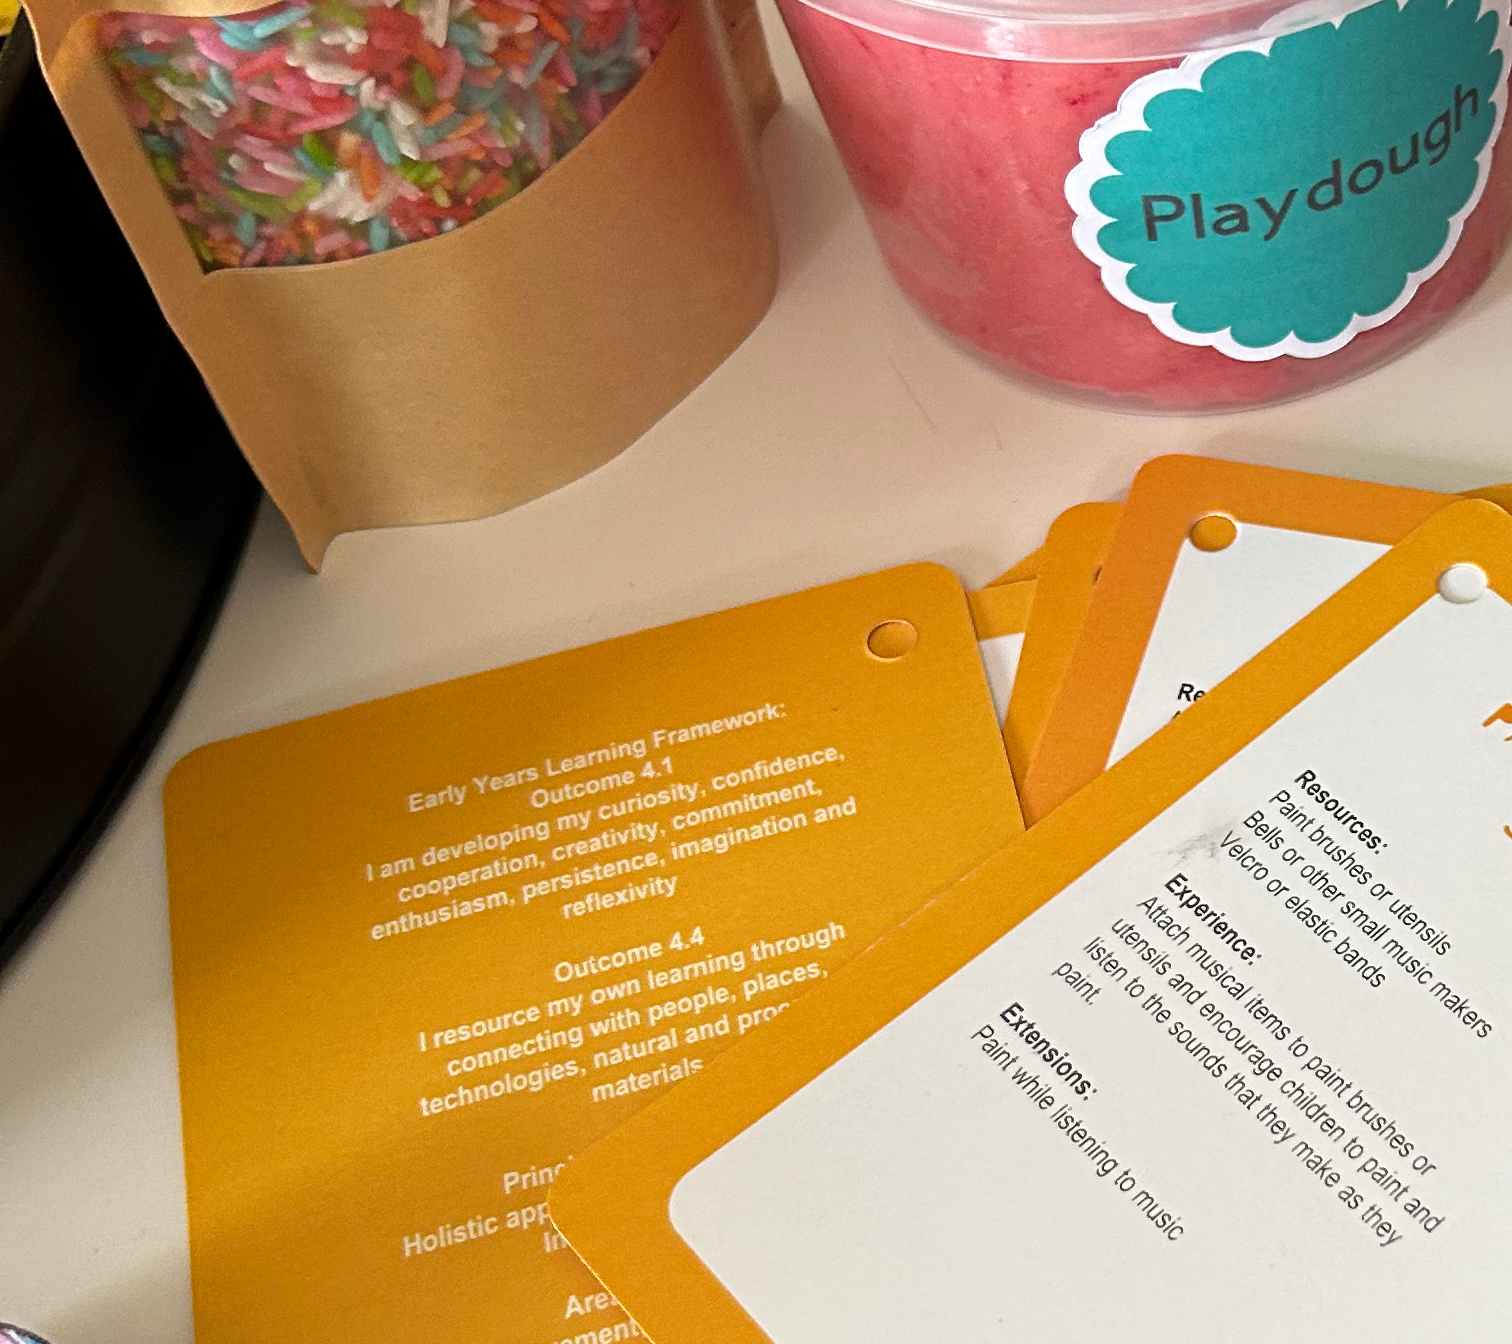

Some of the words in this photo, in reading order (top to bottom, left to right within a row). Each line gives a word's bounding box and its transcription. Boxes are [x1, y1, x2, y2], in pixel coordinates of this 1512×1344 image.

[1141, 83, 1480, 242] Playdough
[365, 863, 373, 881] I
[379, 856, 415, 878] am
[420, 820, 550, 866] developing
[555, 809, 591, 831] my
[597, 782, 706, 820] curiosity,
[710, 746, 845, 790] confidence,
[407, 784, 466, 812] Early
[472, 767, 539, 793] Years
[544, 738, 646, 776] Learning
[650, 702, 786, 748] Framework:
[529, 770, 635, 808] Outcome
[639, 755, 672, 778] 4.1
[1293, 769, 1387, 854] Resources:
[369, 890, 515, 940] enthusiasm,
[521, 851, 665, 903] persistence,
[670, 812, 808, 860] imagination
[813, 795, 856, 823] and
[396, 852, 545, 902] cooperation,
[551, 821, 665, 861] creativity,
[671, 777, 822, 830] commitment,
[559, 875, 677, 919] reflexivity
[1268, 789, 1315, 832] Paint
[1307, 824, 1372, 884] brushes
[1369, 883, 1393, 901] or
[1388, 898, 1451, 955] utensils
[553, 941, 662, 982] Outcome
[667, 925, 704, 950] 4.4
[1164, 872, 1261, 965] Experience:
[1219, 829, 1268, 880] Velcro
[1266, 878, 1290, 896] or
[1284, 895, 1337, 943] elastic
[1332, 936, 1385, 987] bands
[1242, 809, 1284, 850] Bells
[1281, 848, 1305, 866] or
[1299, 864, 1345, 902] other
[1339, 900, 1390, 942] small
[1381, 938, 1433, 984] music
[1428, 981, 1492, 1038] makers
[417, 1031, 427, 1052] I
[432, 1005, 540, 1048] resource
[545, 993, 583, 1016] my
[589, 978, 640, 1004] own
[646, 950, 745, 989] learning
[750, 921, 846, 961] through
[445, 1025, 583, 1076] connecting
[587, 1007, 640, 1037] with
[647, 985, 736, 1026] people,
[741, 962, 828, 1001] places,
[1051, 961, 1101, 1005] paint.
[1136, 896, 1190, 946] Attach
[1185, 942, 1253, 1000] musical
[1243, 993, 1290, 1040] items
[1287, 1035, 1308, 1057] to
[1300, 1055, 1352, 1098] paint
[1345, 1089, 1414, 1157] brushes
[1411, 1155, 1436, 1175] or
[418, 1059, 587, 1116] technologies,
[593, 1027, 678, 1068] natural
[683, 1013, 730, 1044] and
[999, 1001, 1097, 1101] Extensions:
[1082, 936, 1127, 982] listen
[1124, 976, 1145, 997] to
[1141, 992, 1171, 1023] the
[1167, 1021, 1227, 1078] sounds
[1223, 1072, 1262, 1110] that
[1255, 1102, 1295, 1144] they
[1291, 1140, 1340, 1187] make
[1337, 1185, 1363, 1209] as
[1361, 1203, 1402, 1247] they
[1111, 918, 1171, 975] utensils
[1167, 973, 1207, 1005] and
[1199, 1002, 1282, 1081] encourage
[1279, 1079, 1345, 1142] children
[1342, 1136, 1363, 1159] to
[1356, 1157, 1409, 1202] paint
[1403, 1197, 1445, 1233] and
[970, 1023, 1019, 1071] Paint
[1011, 1066, 1054, 1109] while
[1049, 1103, 1118, 1177] listening
[1114, 1168, 1135, 1192] to
[1131, 1189, 1183, 1240] music
[402, 1214, 499, 1257] Holistic
